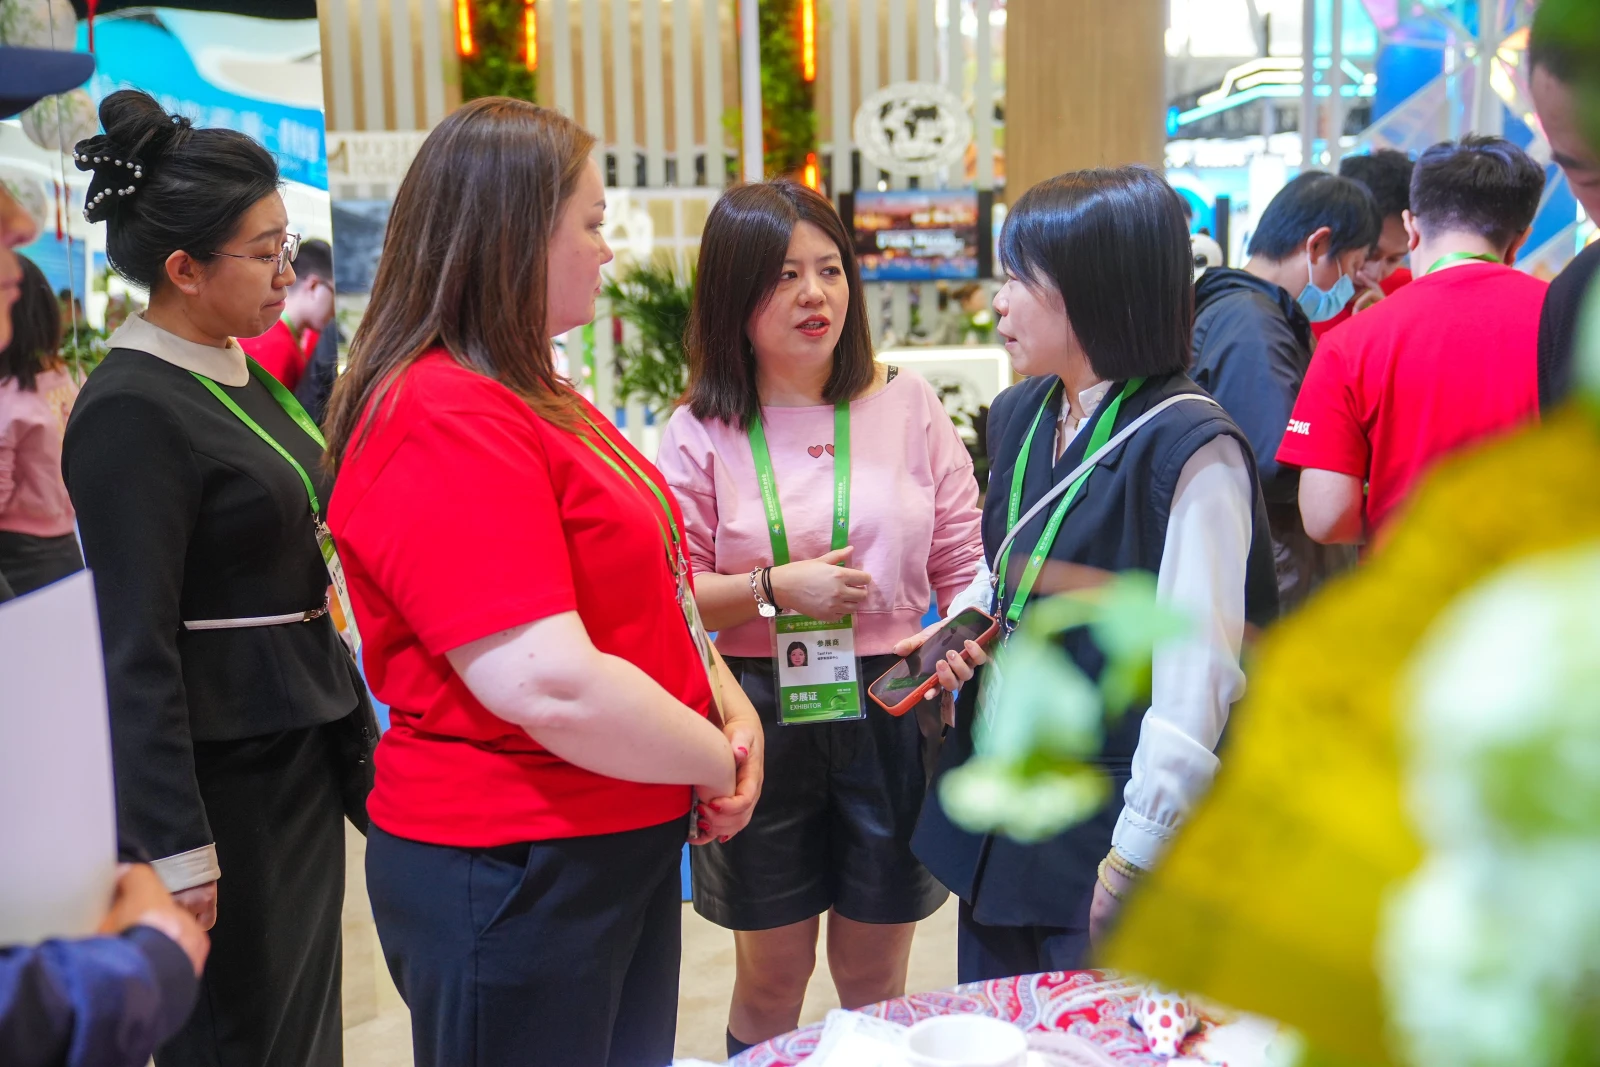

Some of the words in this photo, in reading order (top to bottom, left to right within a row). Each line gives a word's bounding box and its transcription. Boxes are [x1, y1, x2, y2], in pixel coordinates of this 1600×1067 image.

[816, 638, 840, 648] 参展商
[789, 691, 818, 703] 参展证
[789, 702, 822, 711] EXHIBITOR
